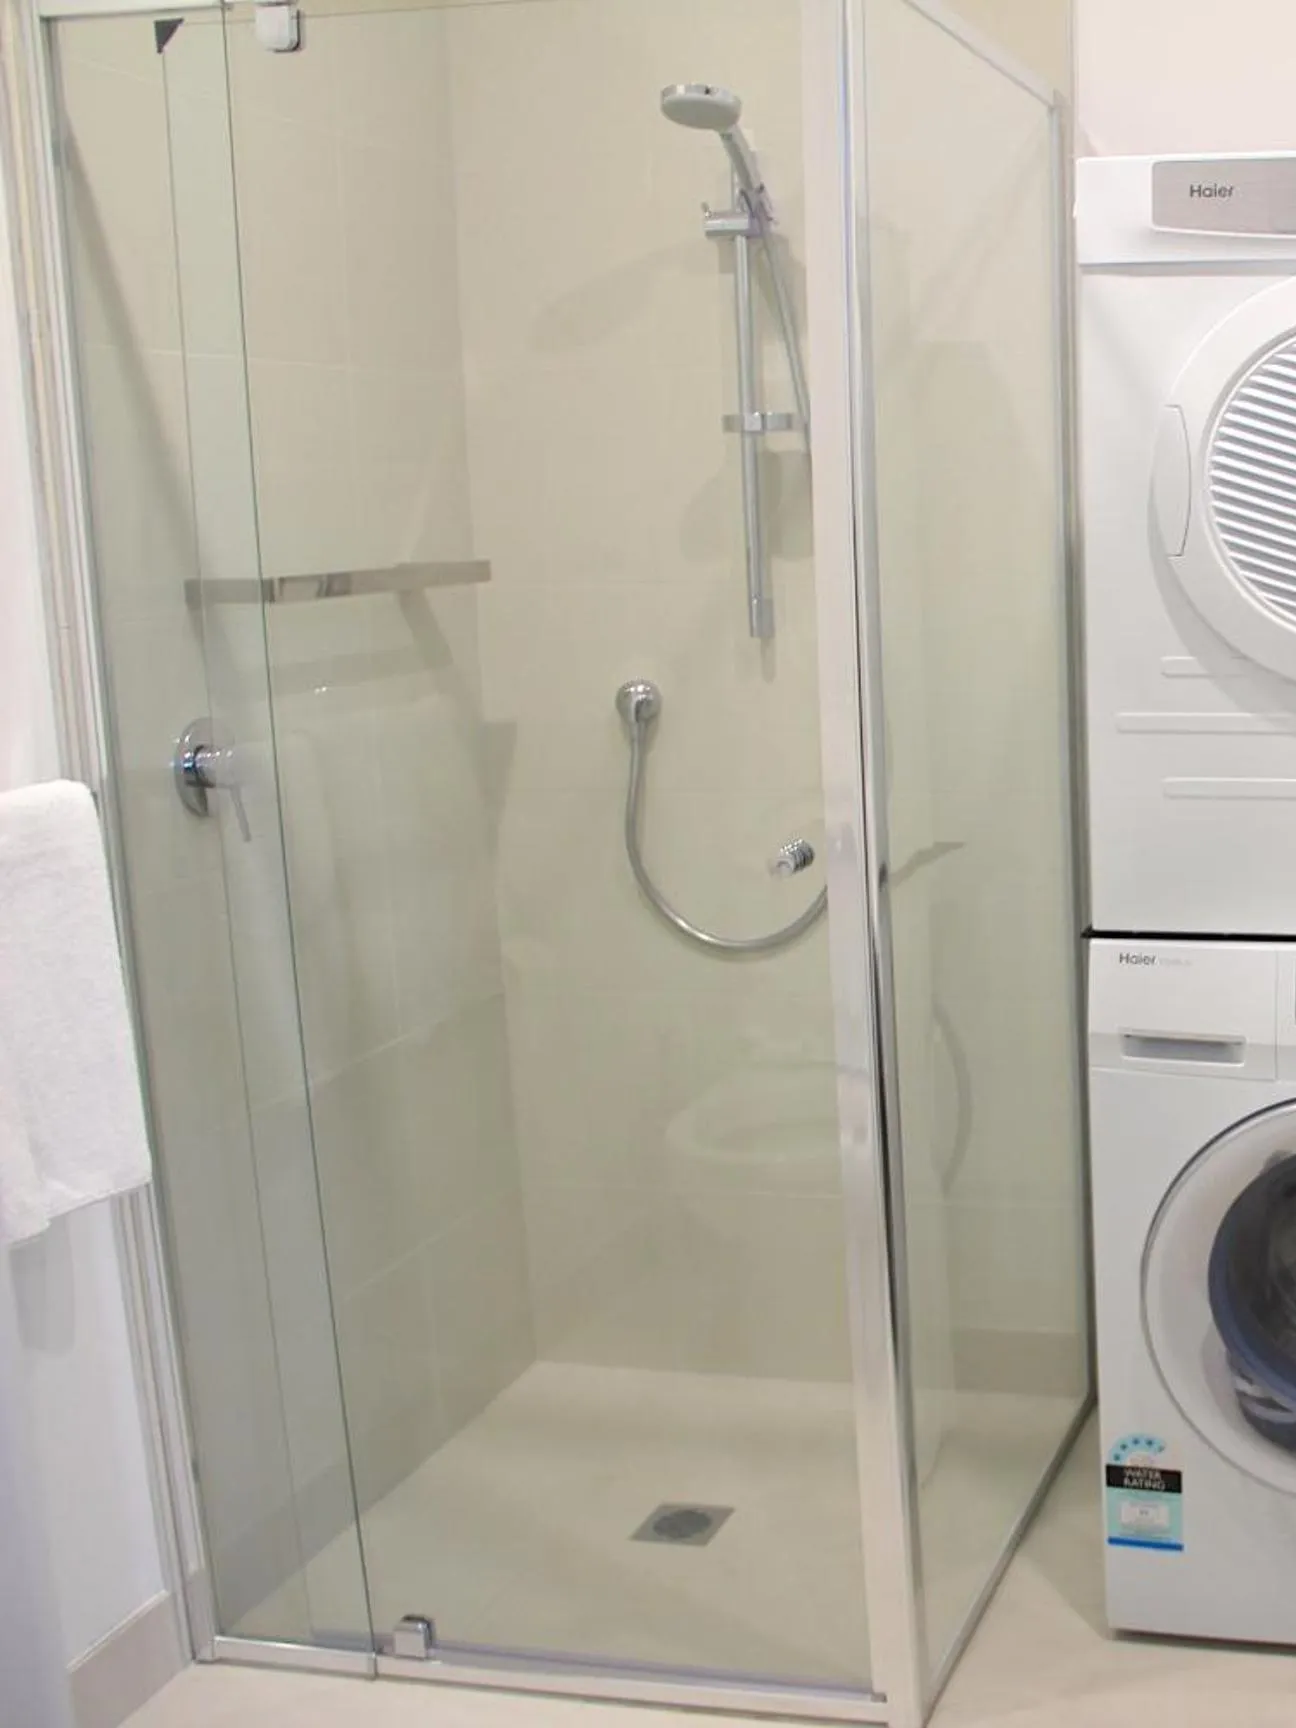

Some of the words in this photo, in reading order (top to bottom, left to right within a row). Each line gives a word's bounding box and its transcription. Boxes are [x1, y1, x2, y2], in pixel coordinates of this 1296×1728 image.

[1189, 182, 1234, 199] Haier
[1119, 952, 1157, 966] Haier
[1123, 1477, 1166, 1491] RATING
